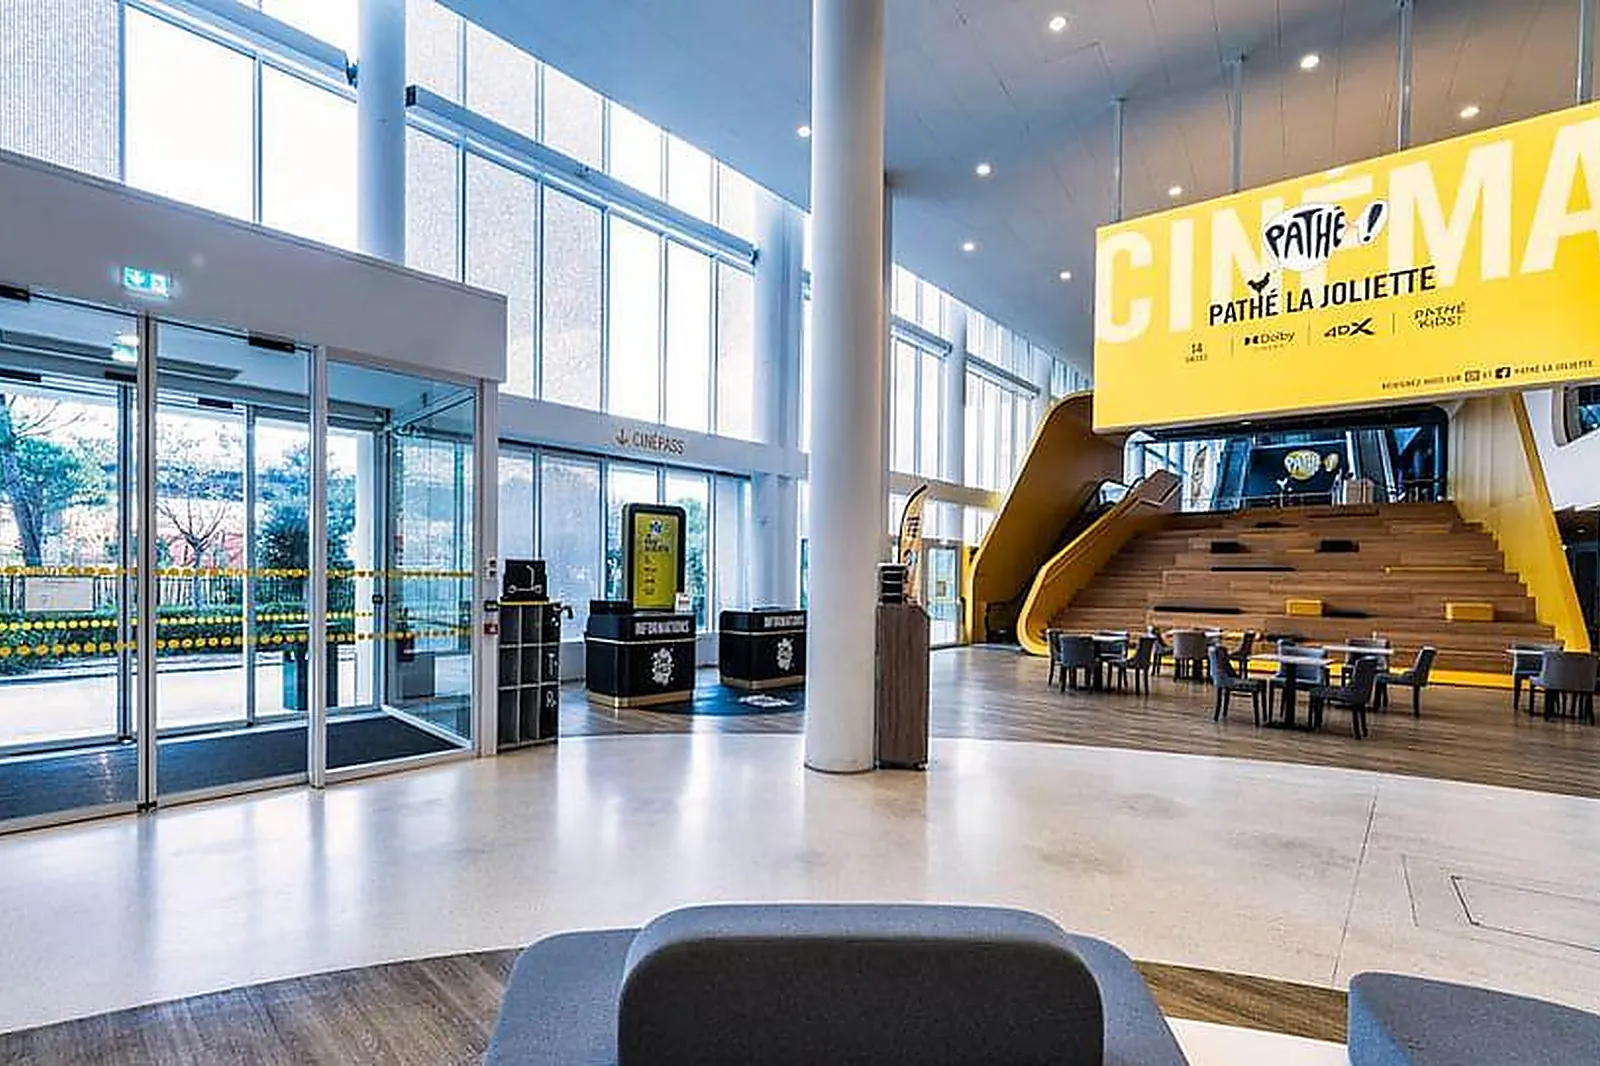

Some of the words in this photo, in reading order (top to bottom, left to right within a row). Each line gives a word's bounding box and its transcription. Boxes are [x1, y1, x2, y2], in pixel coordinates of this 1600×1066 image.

[1265, 206, 1345, 259] PATHÉ
[1208, 288, 1279, 327] PATHÉ
[1287, 288, 1314, 313] LA
[1320, 265, 1436, 309] JOLIETTE
[1259, 331, 1296, 345] Dolby
[1323, 317, 1376, 338] 4DX
[632, 430, 685, 455] CINÉPASS
